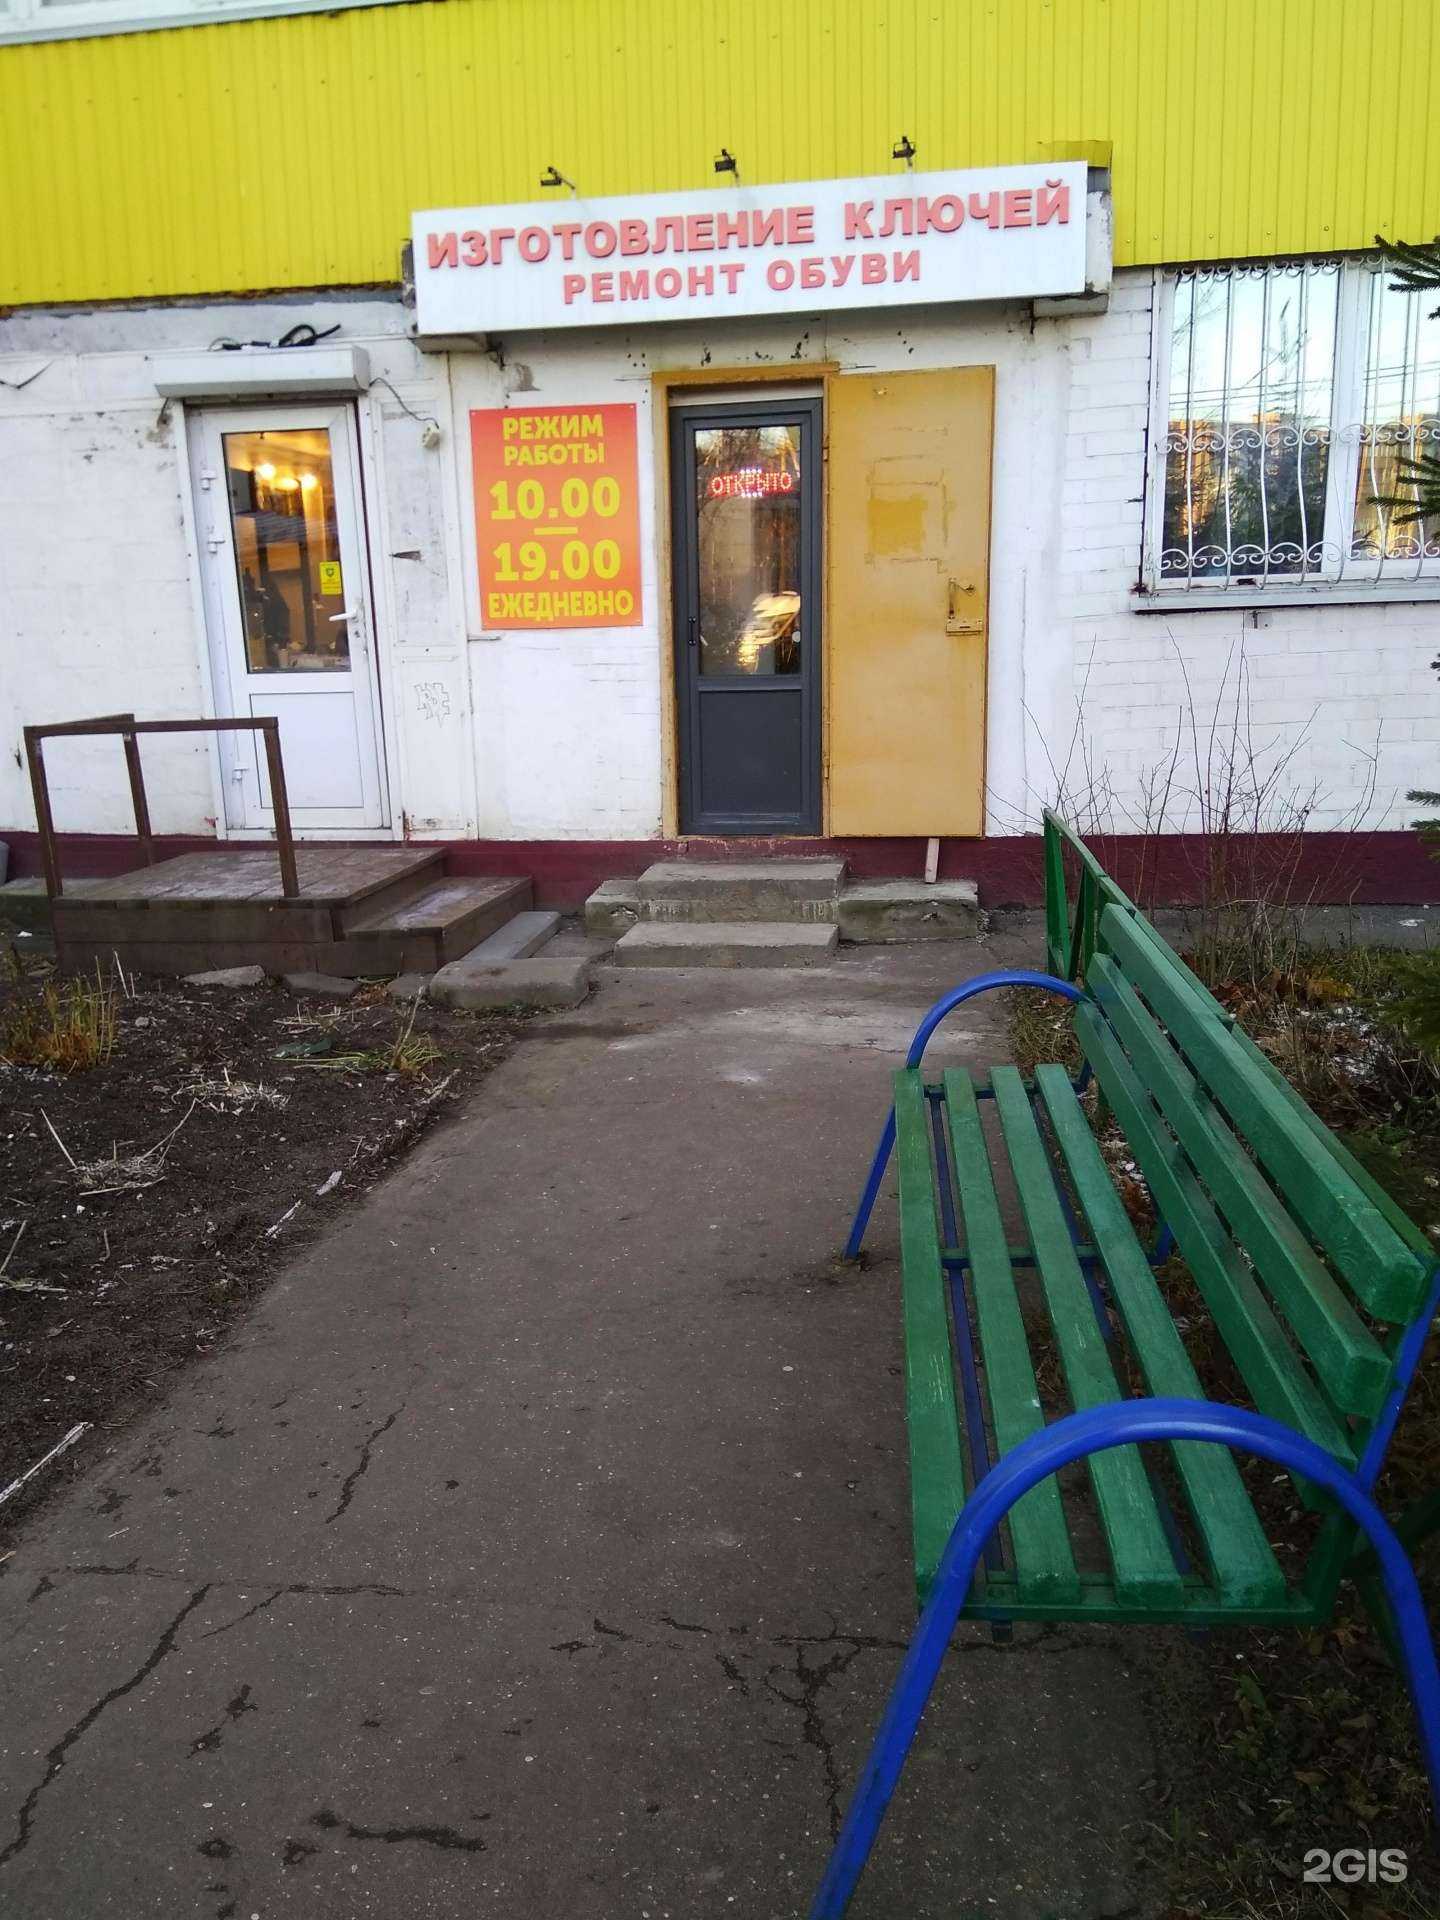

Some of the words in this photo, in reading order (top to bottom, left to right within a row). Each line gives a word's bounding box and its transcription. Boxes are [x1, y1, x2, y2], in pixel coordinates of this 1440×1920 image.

[427, 206, 815, 269] ИЗГОТОВЛЕНИЕ
[844, 180, 1070, 240] КЛЮЧЕЙ
[563, 262, 745, 305] РЕМОНТ
[766, 250, 921, 291] ОБУВИ
[502, 414, 604, 440] РЕЖИМ
[504, 443, 605, 466] РАБОТЫ
[489, 477, 621, 520] 10.00
[711, 472, 792, 494] ОТКРЫТО
[493, 539, 622, 581] 19.00
[488, 590, 634, 620] ЕЖЕДНЕВНО
